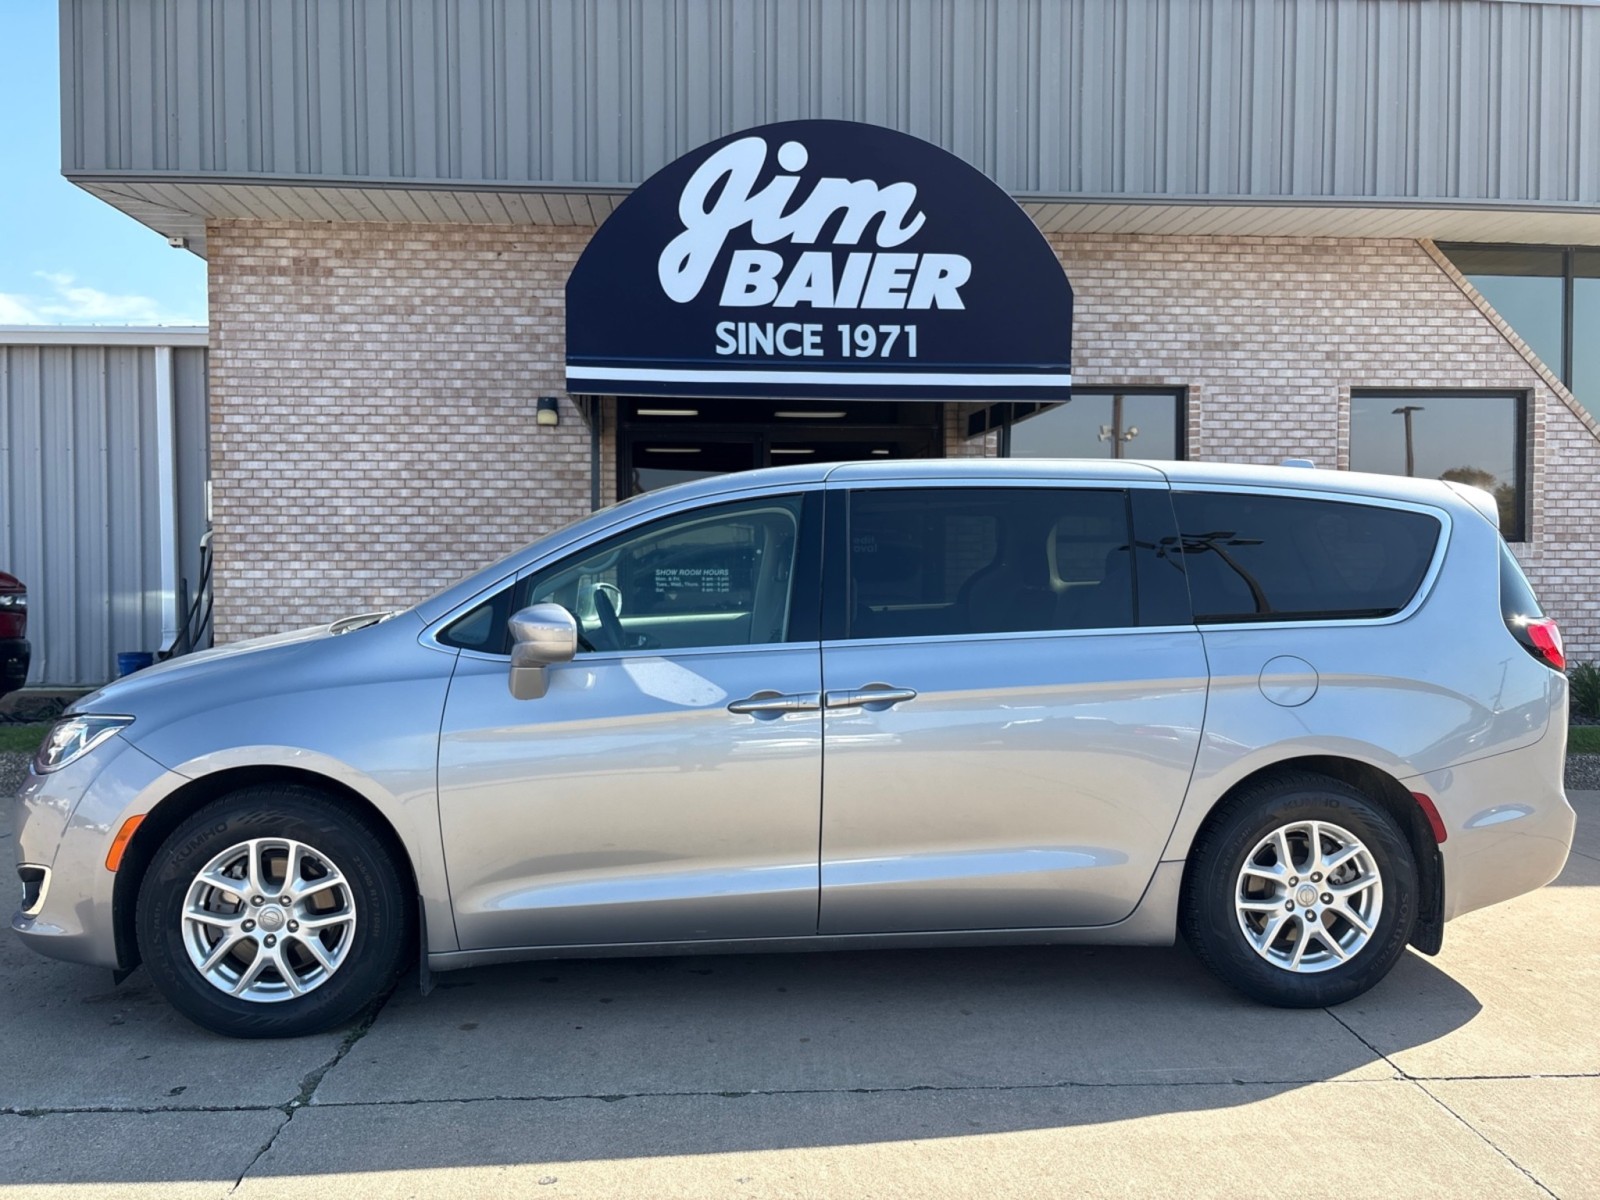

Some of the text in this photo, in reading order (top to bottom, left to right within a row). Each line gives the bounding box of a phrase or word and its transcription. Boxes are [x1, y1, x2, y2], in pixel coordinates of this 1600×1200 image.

[658, 136, 926, 303] Jim
[719, 249, 972, 310] BAIER
[715, 321, 918, 358] SINCE 1971
[171, 821, 228, 868] KUMHO
